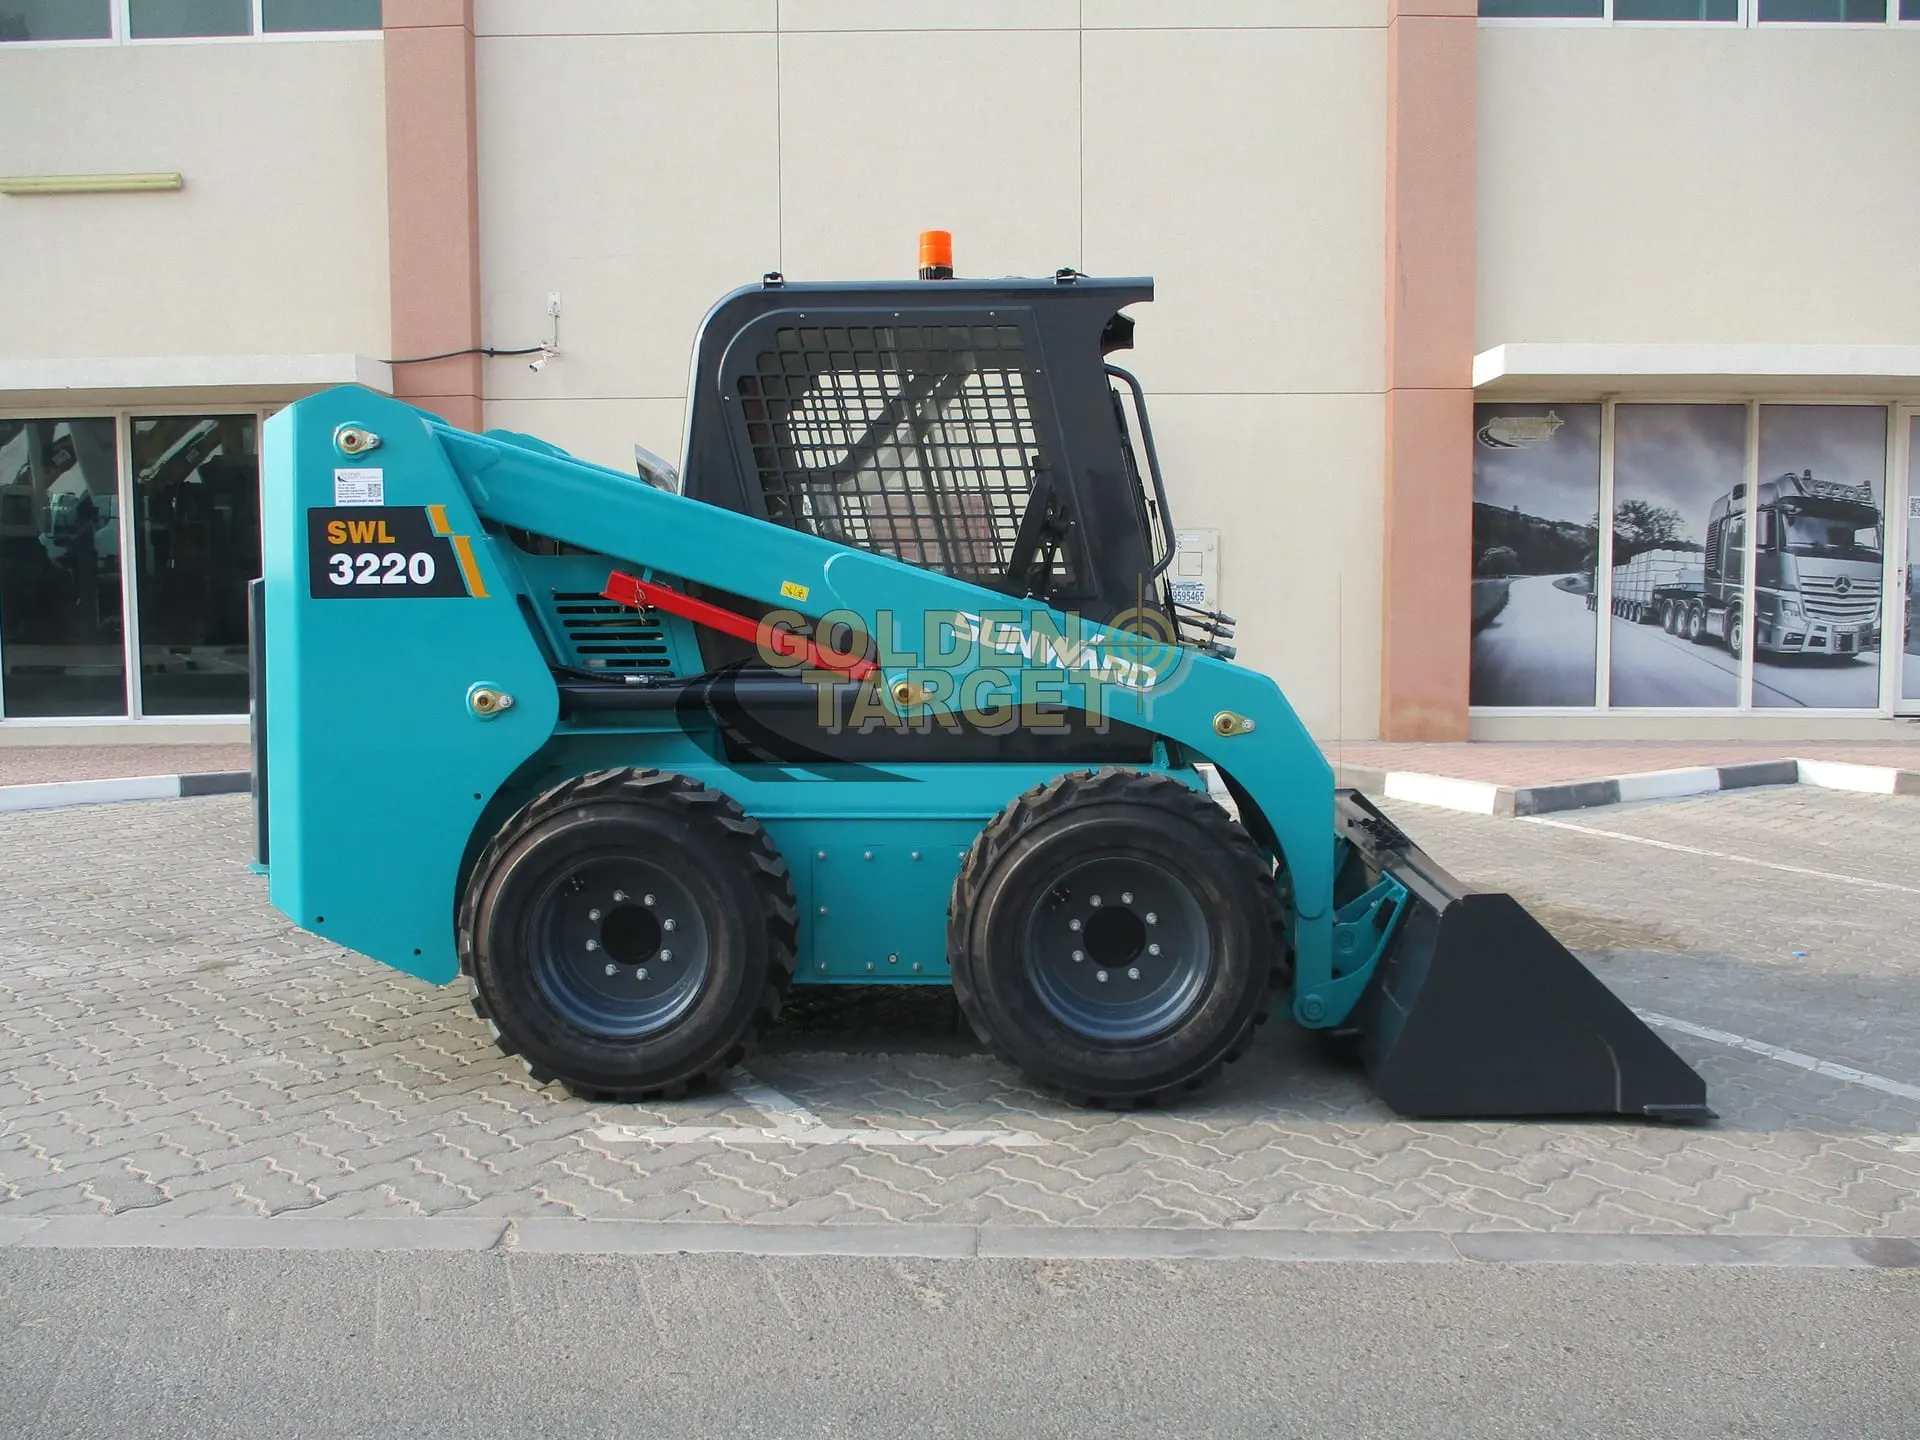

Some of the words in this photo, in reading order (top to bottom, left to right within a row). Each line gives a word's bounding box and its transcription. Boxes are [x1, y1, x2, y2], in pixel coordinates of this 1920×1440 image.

[327, 520, 395, 544] SWL
[328, 552, 436, 585] 3220
[951, 611, 1157, 692] SUNWARD
